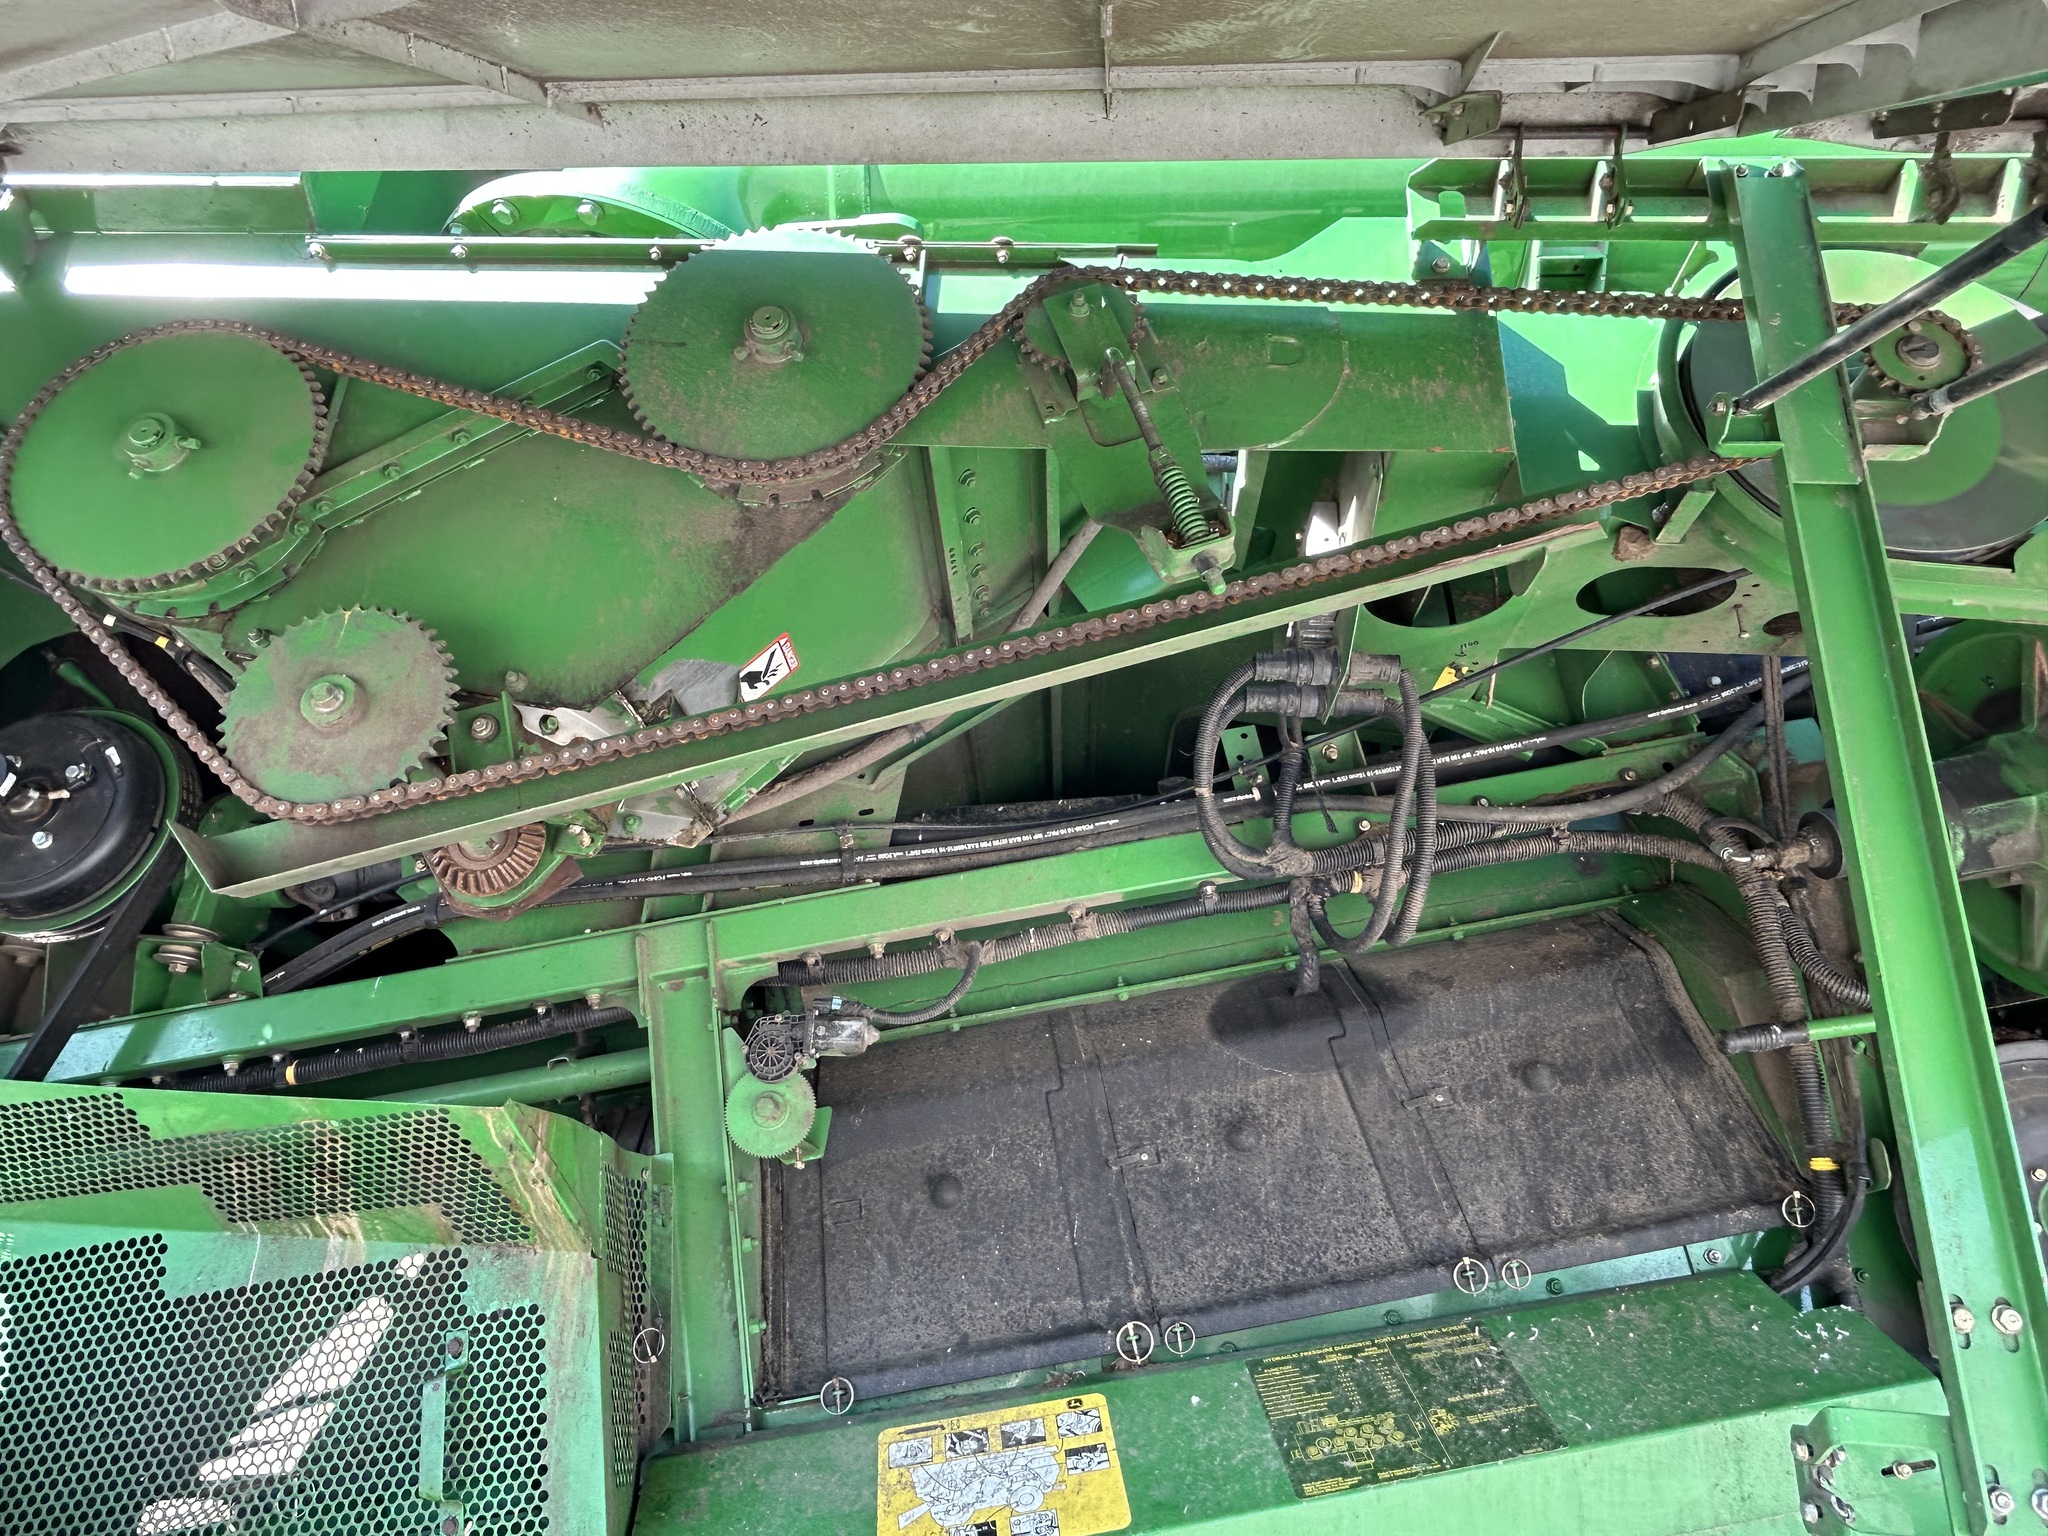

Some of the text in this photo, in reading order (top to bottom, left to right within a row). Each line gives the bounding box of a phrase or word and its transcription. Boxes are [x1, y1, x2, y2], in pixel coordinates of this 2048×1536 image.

[1262, 1352, 1299, 1363] HYDRAULIC
[1299, 1346, 1333, 1357] PRESSURE
[1333, 1339, 1372, 1351] DIAGNOSTIC
[1396, 1333, 1410, 1341] AND
[1410, 1328, 1440, 1339] CONTROL
